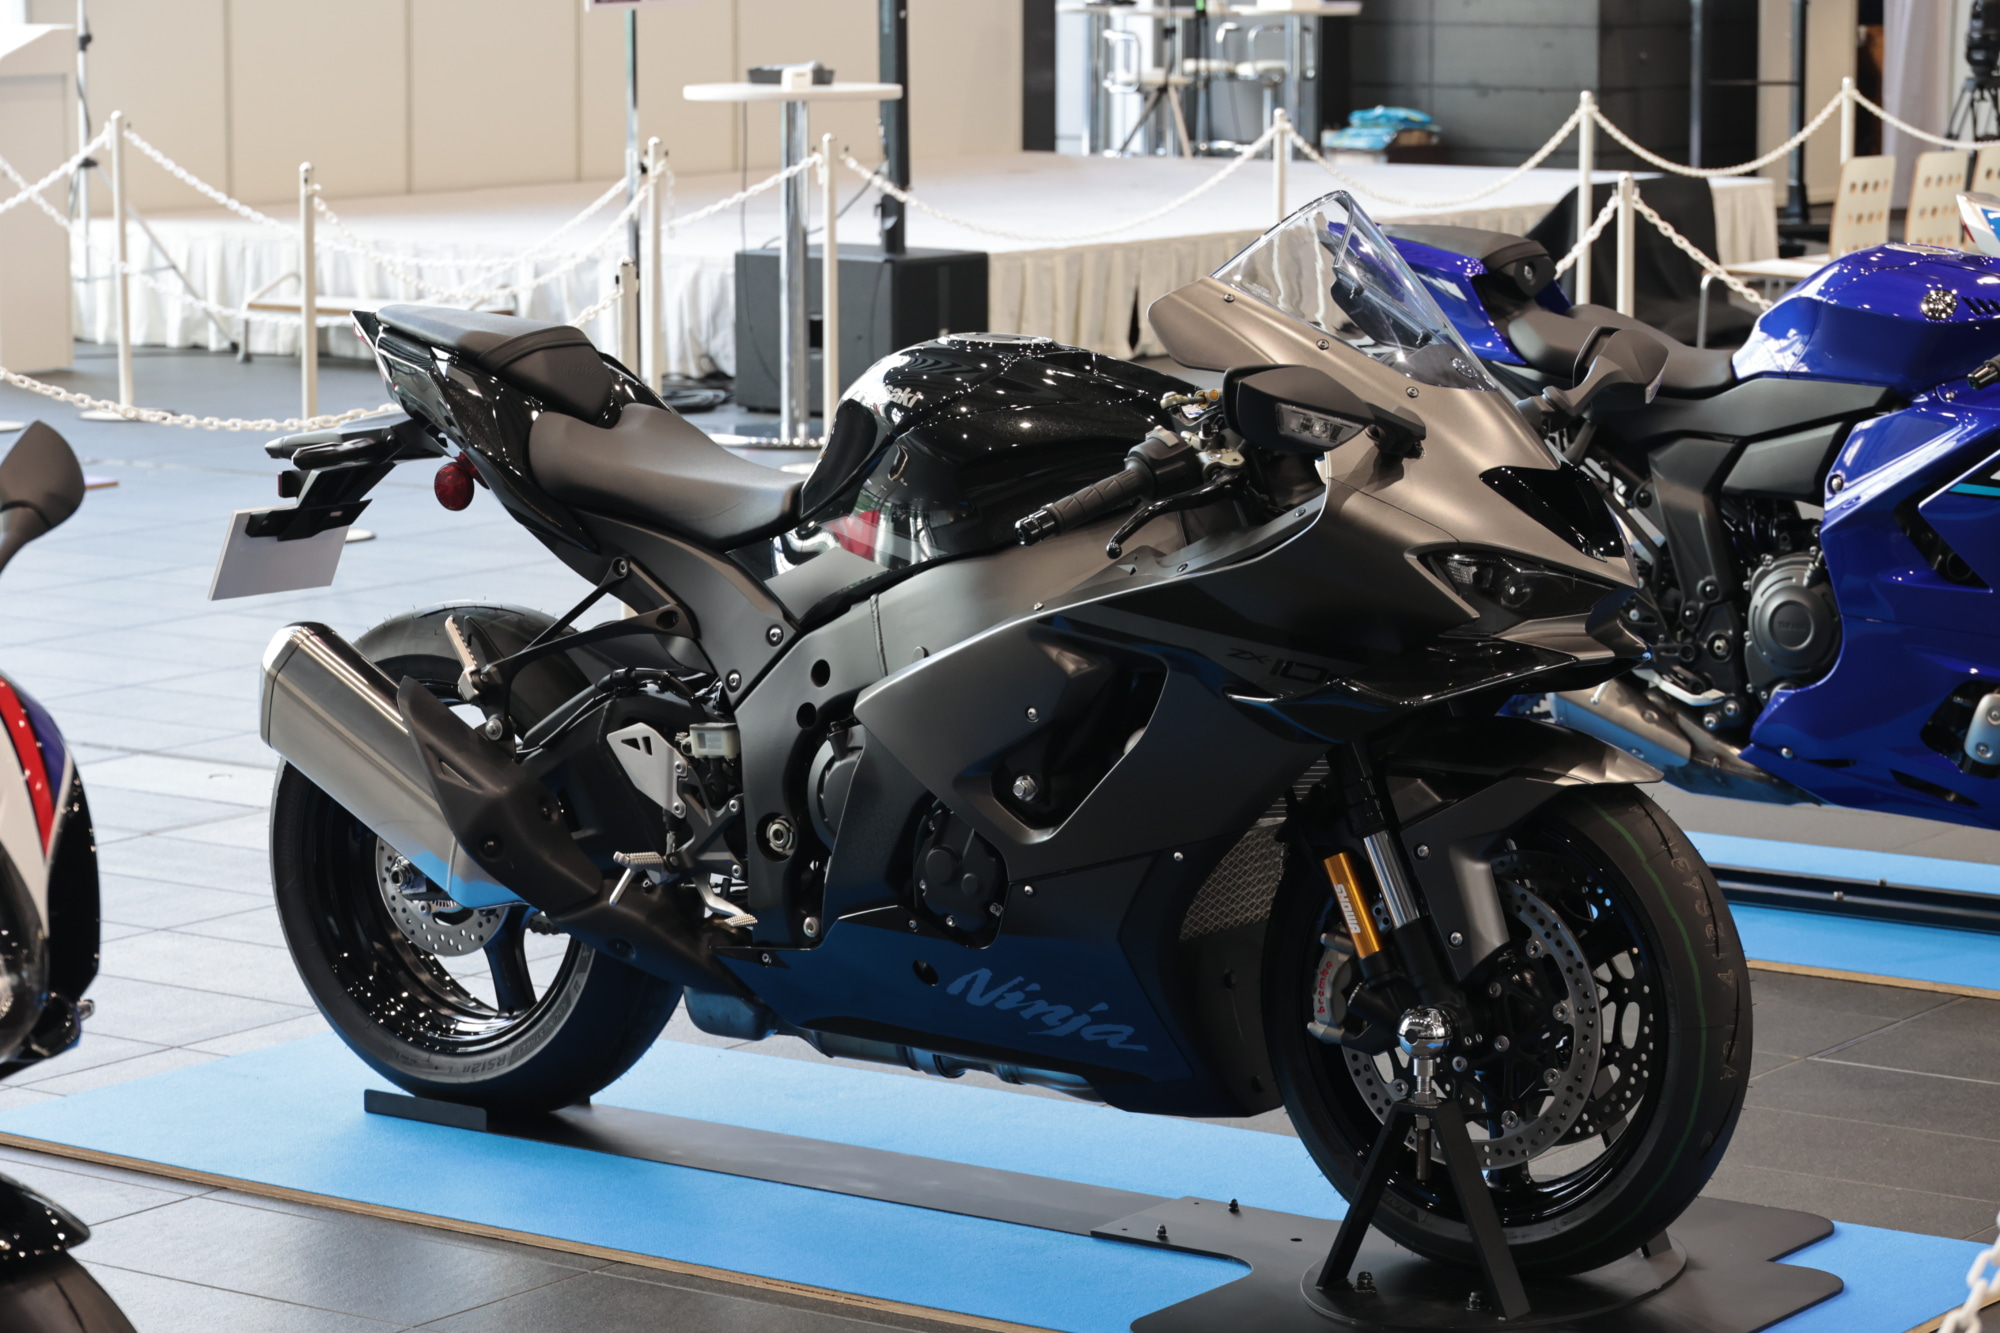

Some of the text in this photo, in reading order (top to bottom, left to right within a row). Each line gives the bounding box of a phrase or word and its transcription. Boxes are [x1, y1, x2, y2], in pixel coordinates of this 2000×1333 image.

[1333, 883, 1361, 934] SHOWA
[946, 967, 1148, 1051] Ninja
[1316, 961, 1333, 1014] brembo
